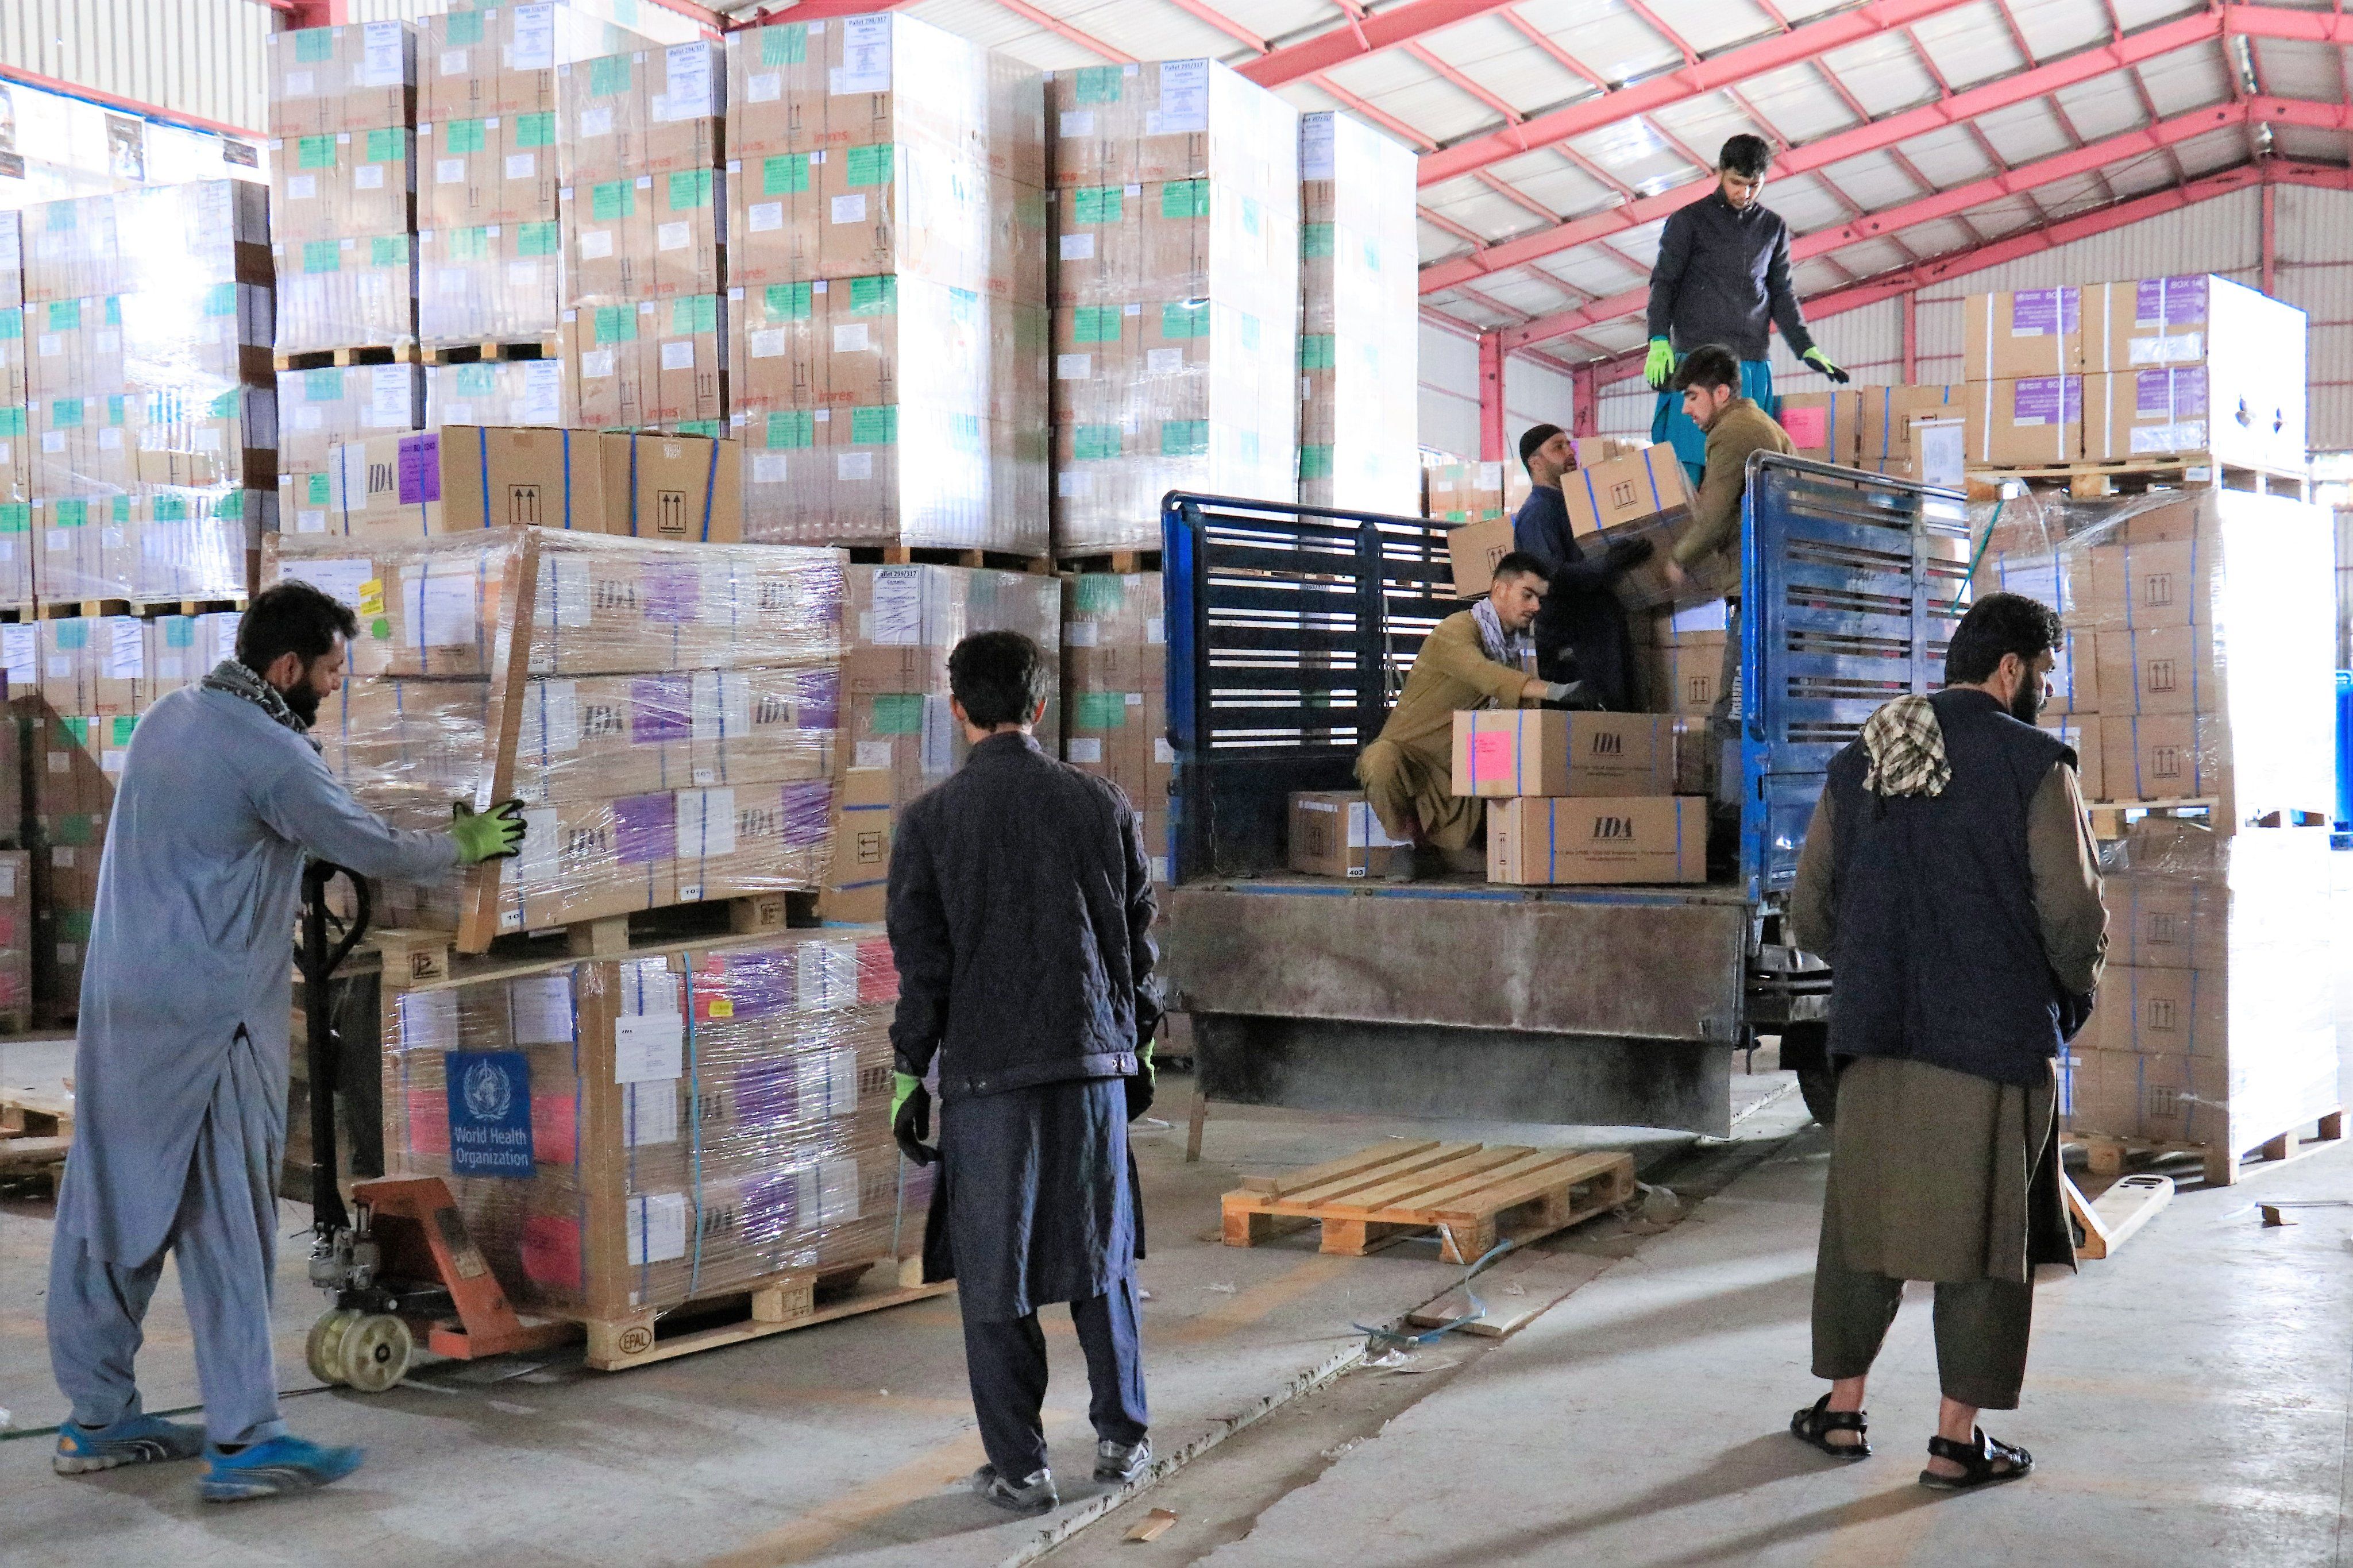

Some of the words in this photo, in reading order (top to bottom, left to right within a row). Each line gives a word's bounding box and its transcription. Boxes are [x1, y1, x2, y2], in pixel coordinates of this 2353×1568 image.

[849, 19, 863, 28] Pallet
[368, 462, 394, 493] IDA
[755, 699, 790, 724] IDA
[1592, 733, 1621, 753] IDA
[741, 809, 775, 837] IDA
[1594, 817, 1632, 838] IDA
[454, 1126, 487, 1144] World
[490, 1127, 527, 1145] Health
[456, 1148, 529, 1168] Organization
[623, 1333, 646, 1350] EPAL
